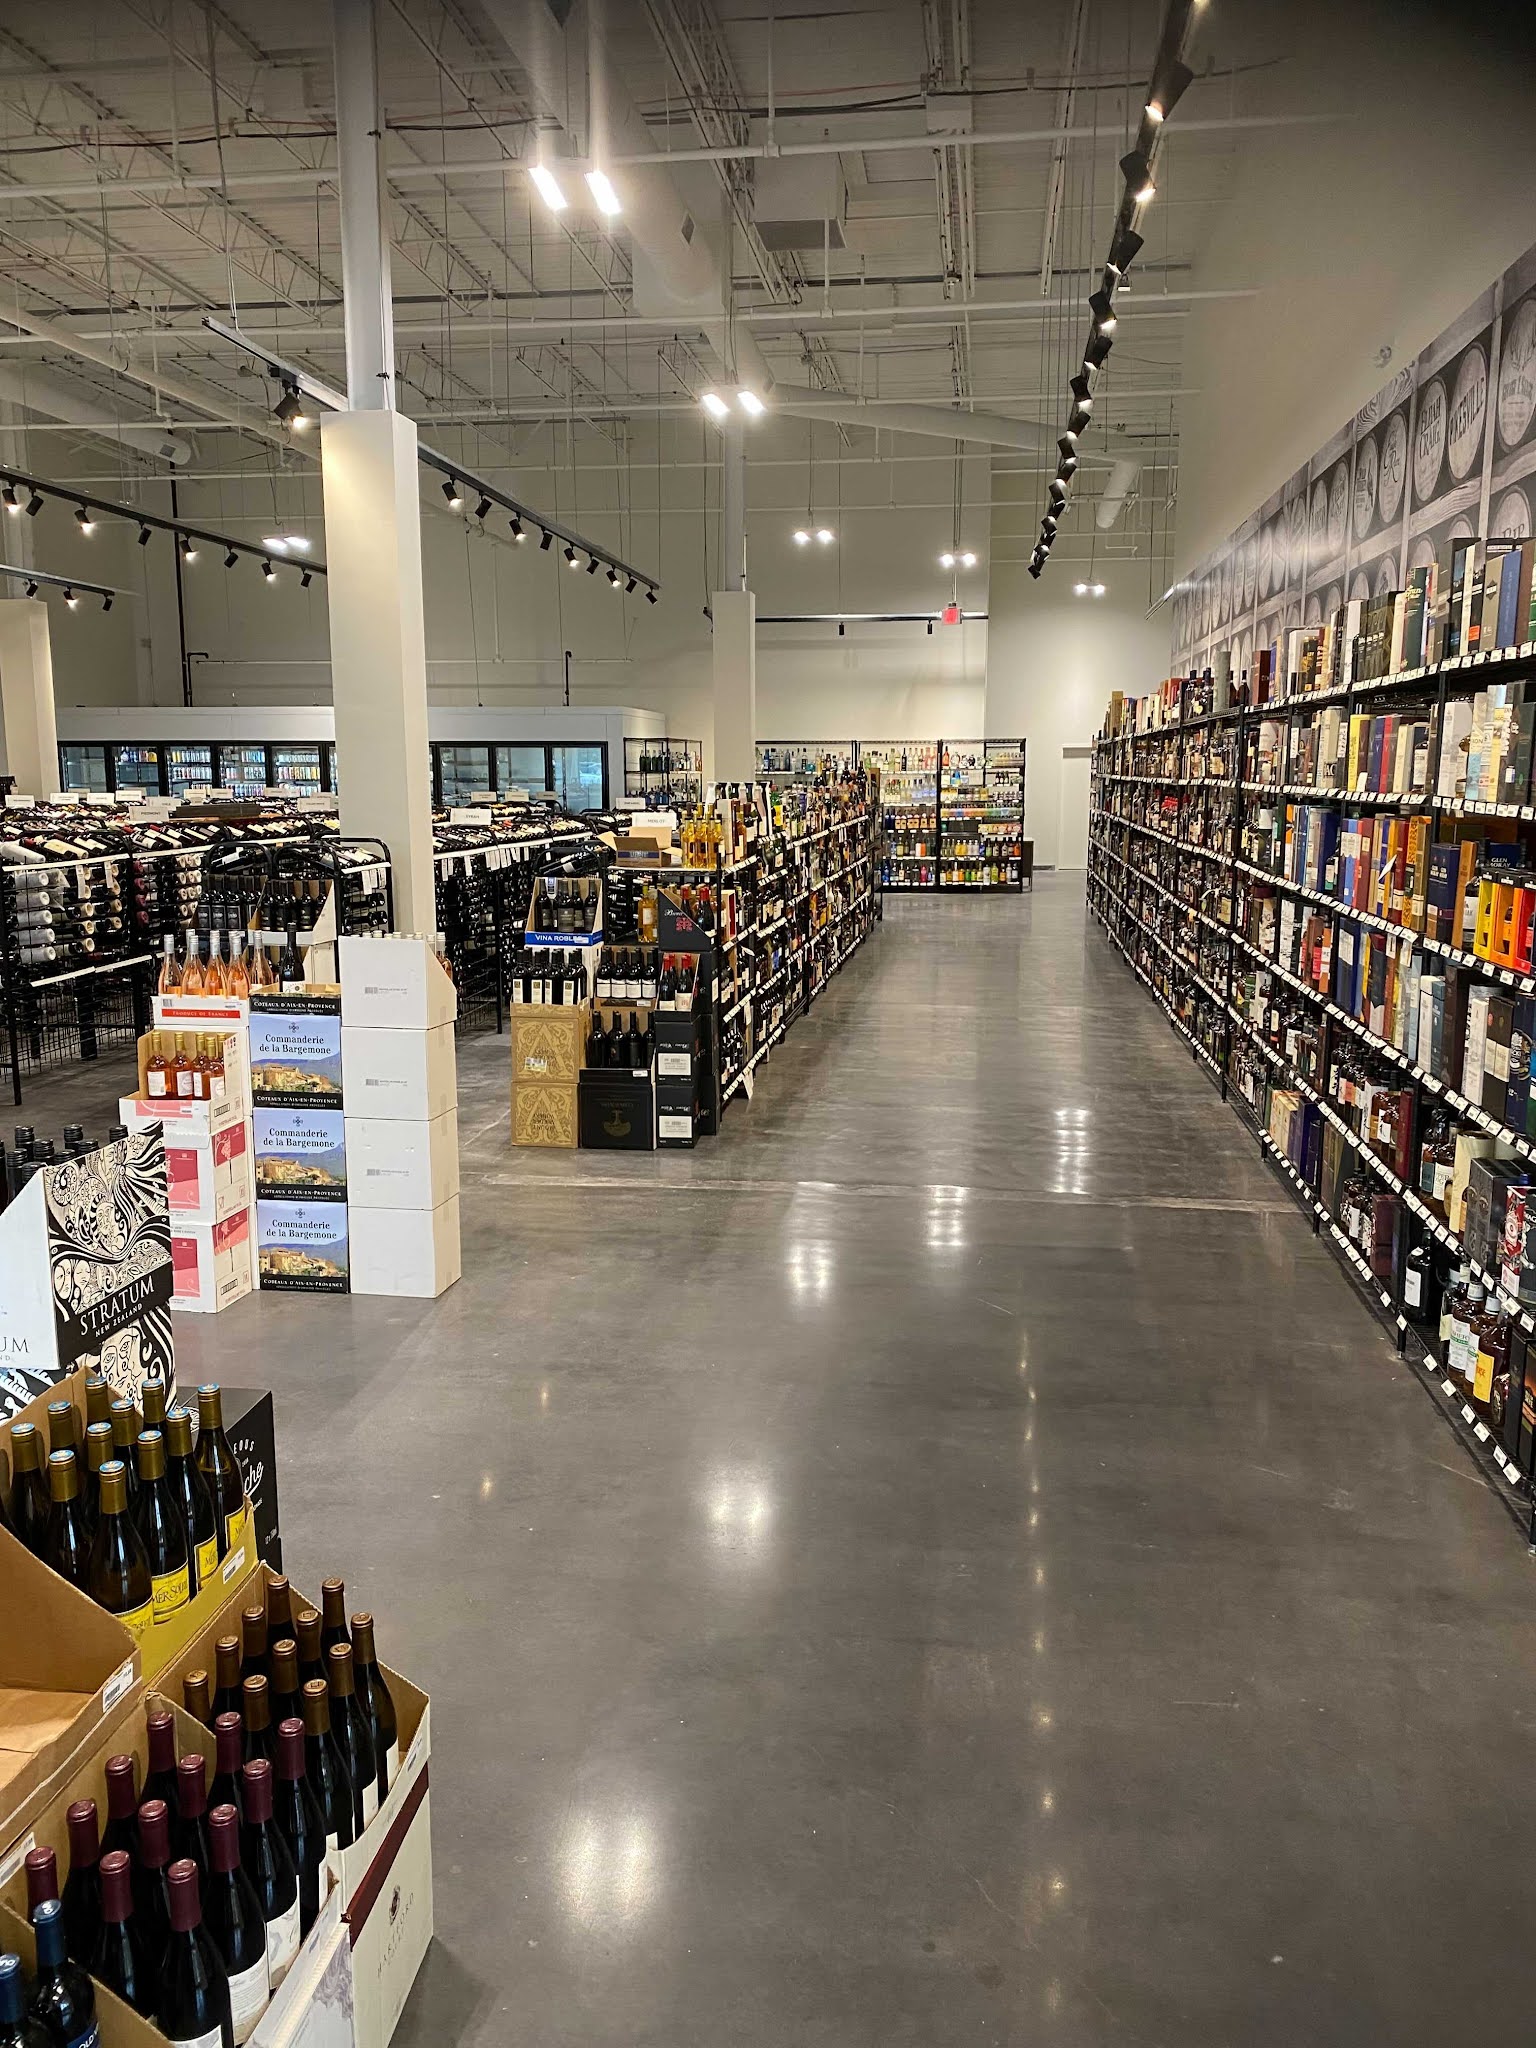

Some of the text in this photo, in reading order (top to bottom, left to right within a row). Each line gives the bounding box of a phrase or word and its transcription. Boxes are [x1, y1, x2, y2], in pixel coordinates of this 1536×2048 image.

[1420, 420, 1441, 459] CRAIG
[265, 1034, 325, 1044] Commanderie
[259, 1044, 331, 1055] de la Bargemone
[269, 1128, 328, 1138] Commanderie
[263, 1138, 335, 1148] de la Bargemone
[272, 1219, 330, 1229] Commanderie
[266, 1229, 337, 1239] de la Bargemone
[80, 1275, 155, 1336] STRATUM
[95, 1303, 143, 1338] NEW ZEALAND
[233, 1439, 255, 1455] EOUS
[244, 1461, 264, 1497] che
